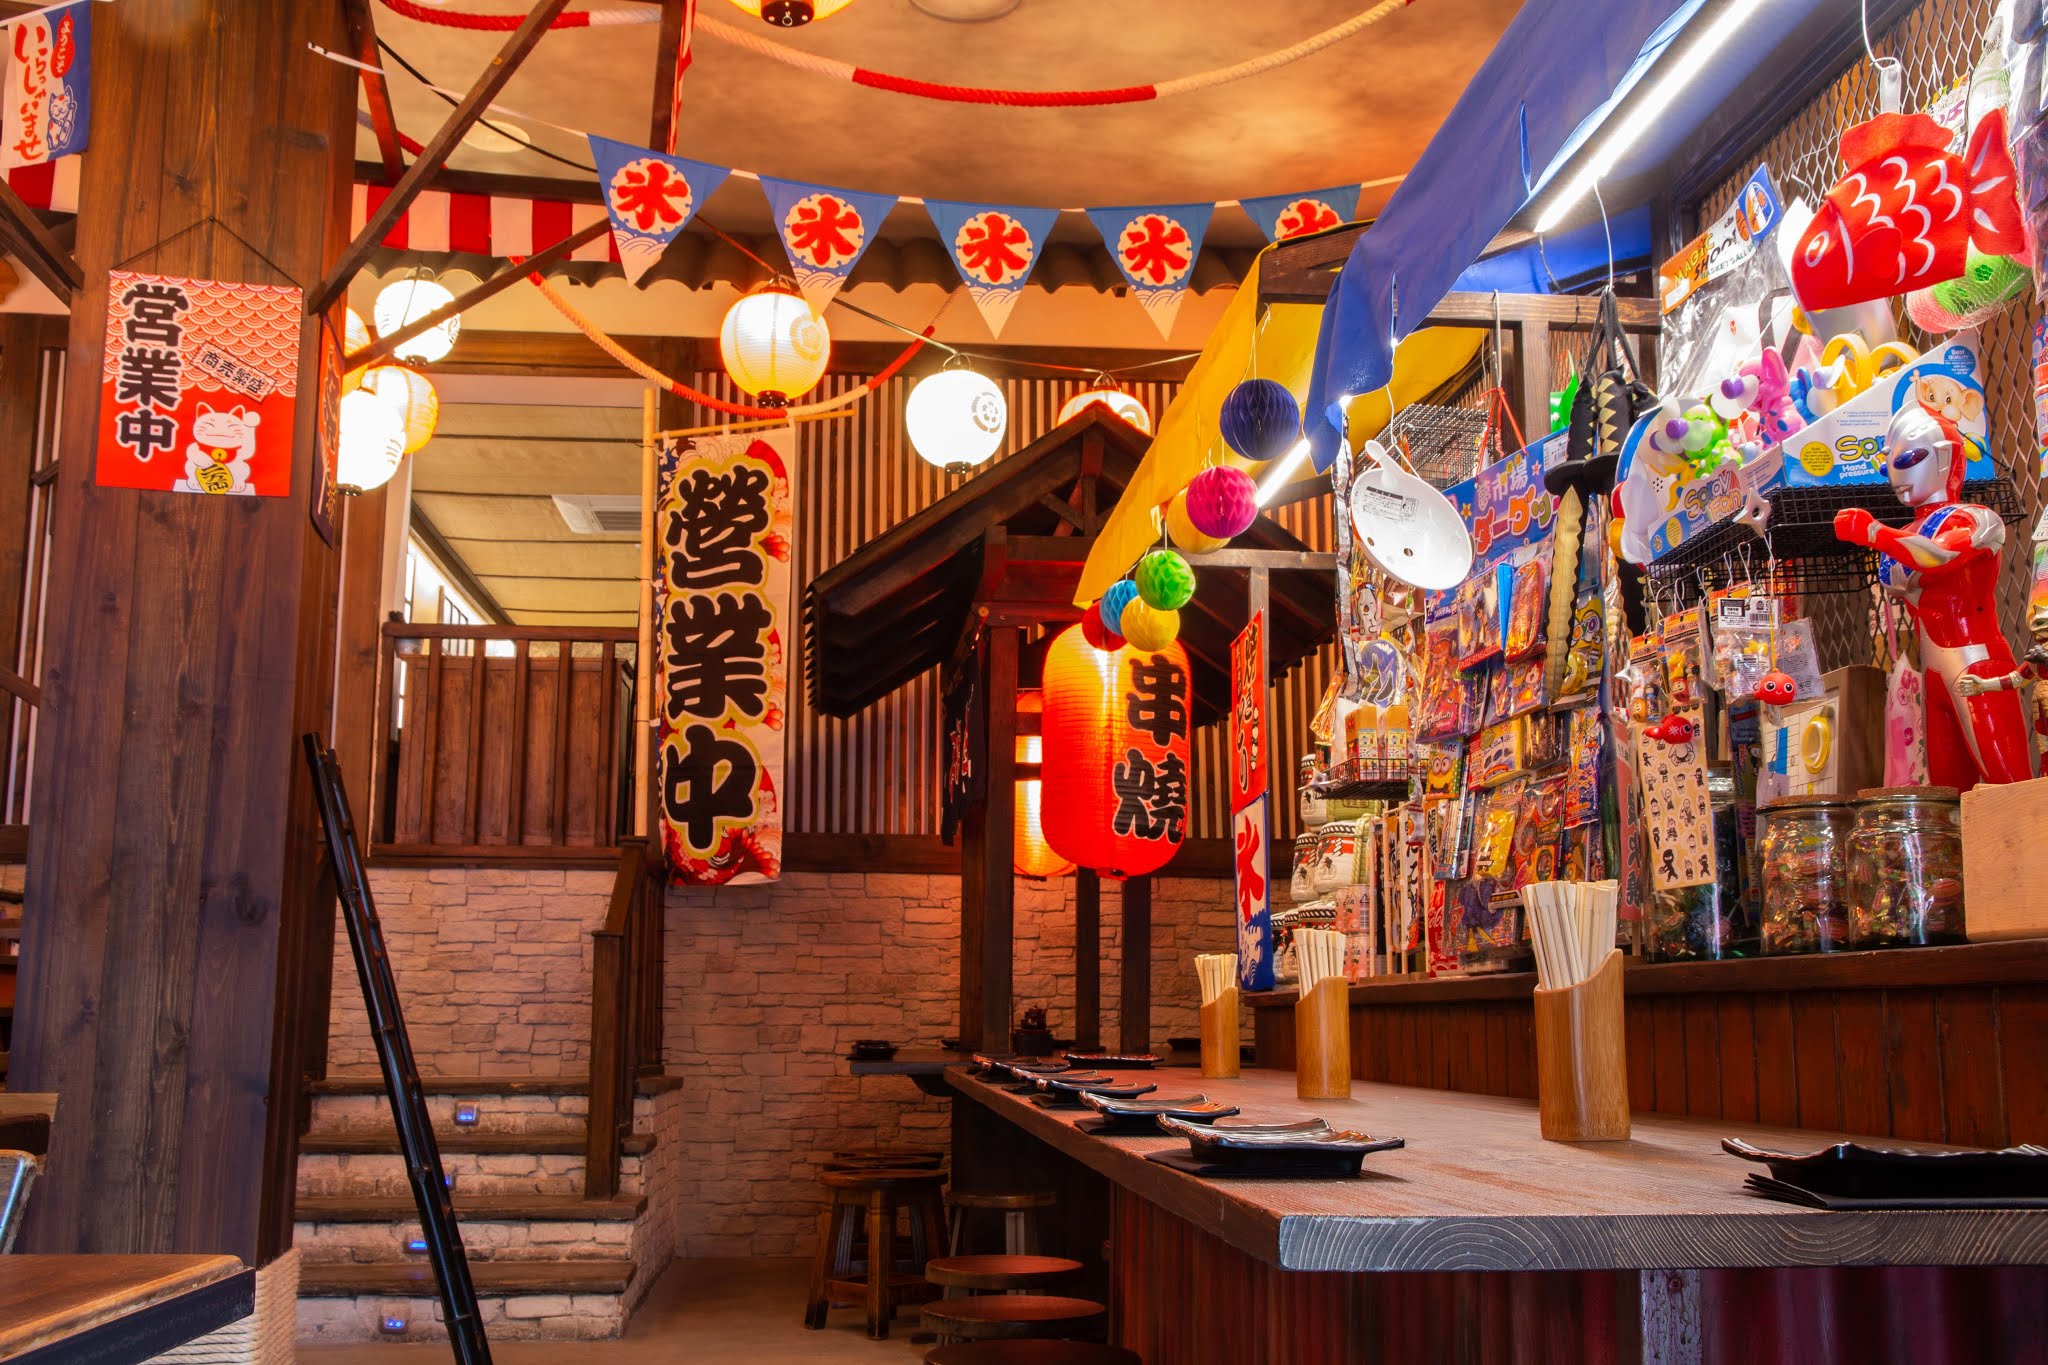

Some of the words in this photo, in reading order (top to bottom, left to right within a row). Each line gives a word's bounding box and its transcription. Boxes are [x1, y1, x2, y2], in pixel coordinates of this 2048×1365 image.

[56, 20, 71, 73] ようこそ
[13, 23, 48, 161] いらっしゃいませ
[616, 162, 690, 231] 氷
[791, 197, 860, 265] 氷
[962, 214, 1027, 283] 氷
[1119, 217, 1187, 284] 氷
[1675, 233, 1715, 285] MAGIC
[118, 283, 189, 459] 営業中
[201, 350, 266, 395] 商売繁盛
[1835, 434, 1886, 462] Spr
[1839, 468, 1876, 480] pressure
[1842, 463, 1867, 473] Hand
[1572, 615, 1601, 641] oyo
[1236, 814, 1265, 923] 氷
